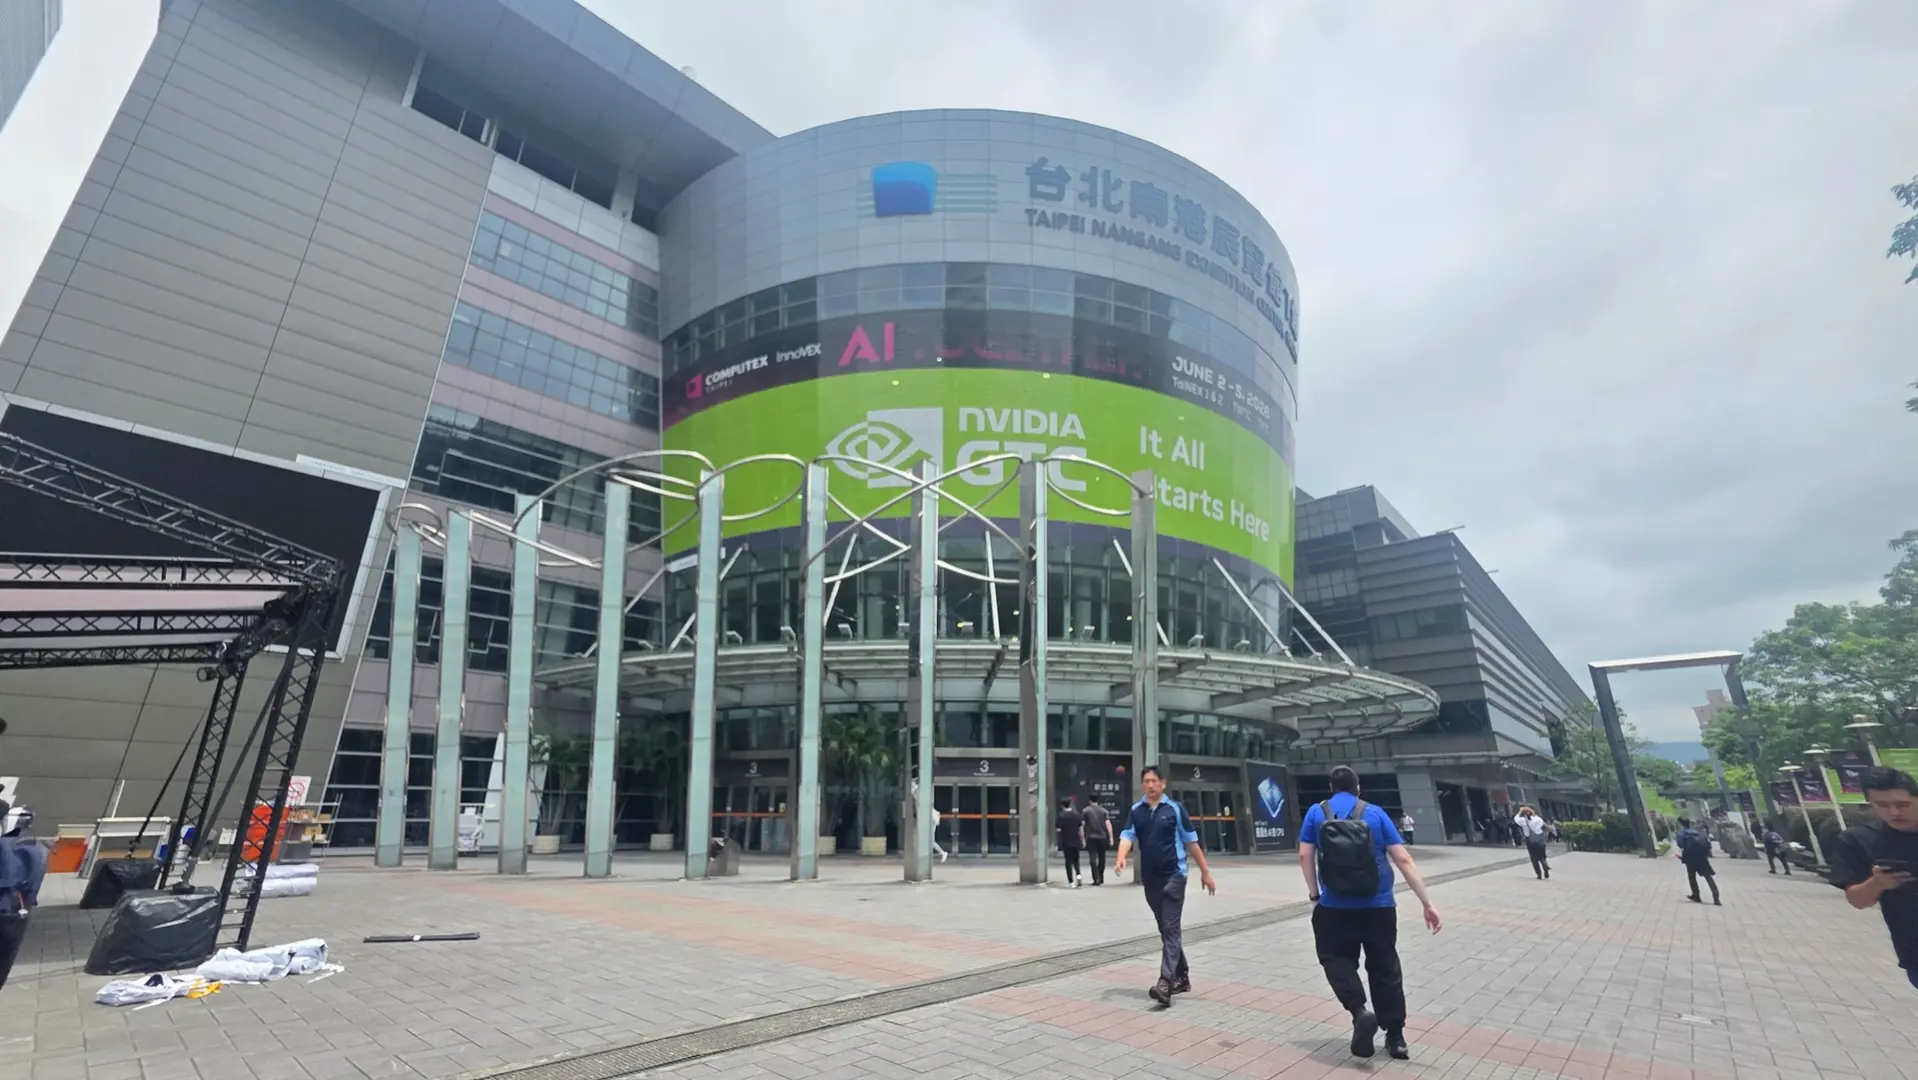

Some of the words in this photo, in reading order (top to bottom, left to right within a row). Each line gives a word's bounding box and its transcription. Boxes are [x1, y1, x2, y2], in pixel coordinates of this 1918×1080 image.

[1024, 208, 1086, 234] TAIPEI
[1092, 218, 1181, 262] NANGANG
[839, 322, 895, 366] AI
[705, 354, 769, 386] COMPUTEX
[1172, 356, 1214, 385] JUNE
[1217, 374, 1226, 392] 2
[1217, 393, 1224, 406] 2
[1140, 424, 1163, 459] It
[1171, 435, 1205, 471] All
[956, 440, 1087, 492] GTC
[1154, 474, 1224, 521] tarts
[1231, 498, 1270, 542] Here
[750, 761, 758, 774] 3
[979, 759, 990, 773] 3
[1193, 766, 1201, 779] 3
